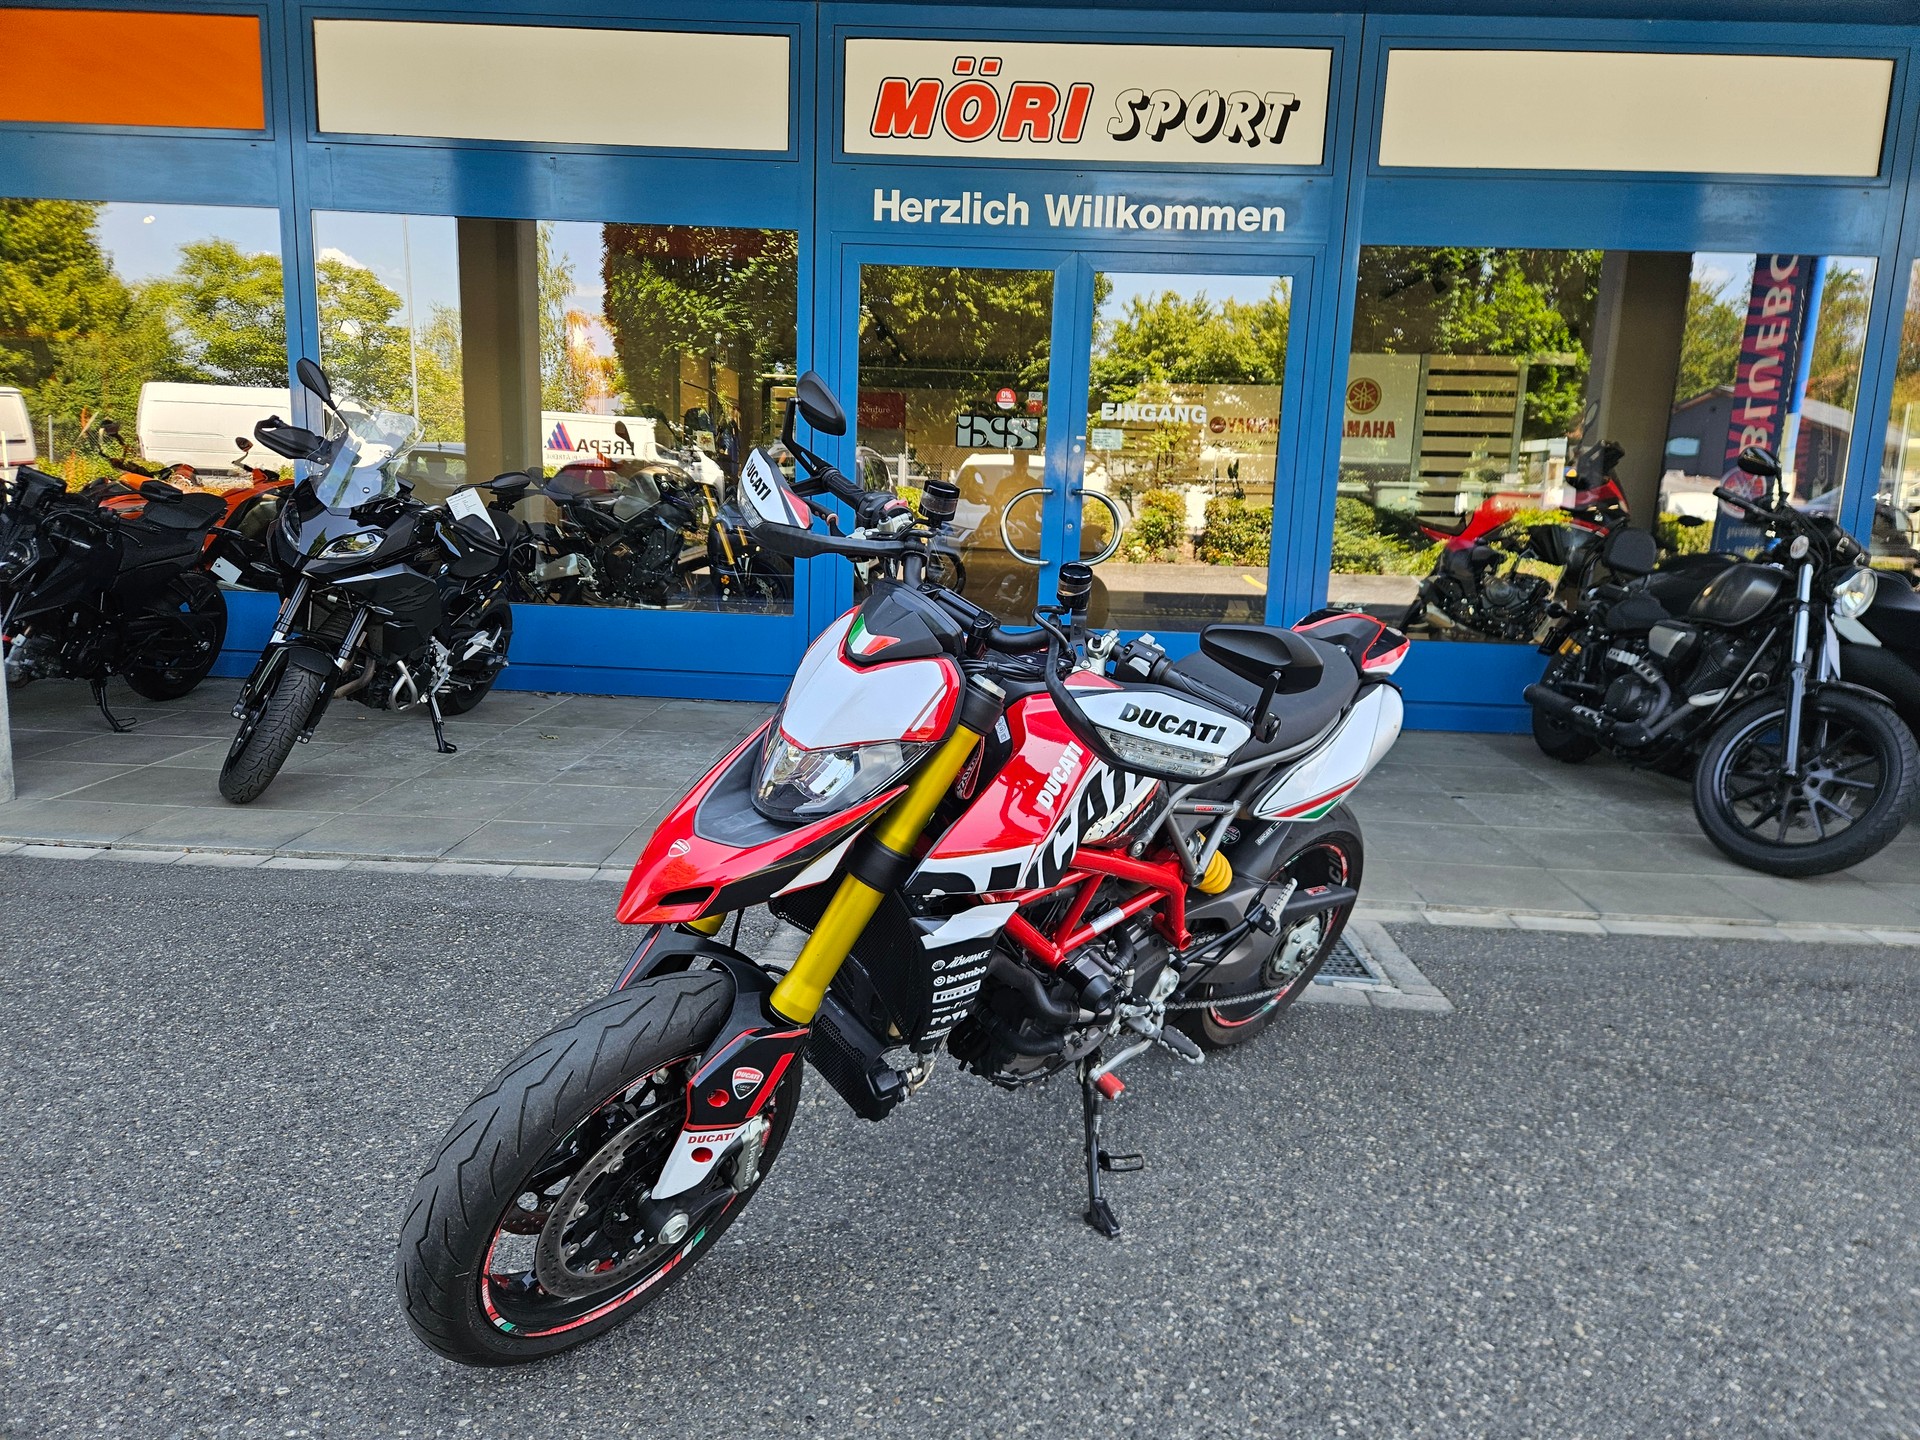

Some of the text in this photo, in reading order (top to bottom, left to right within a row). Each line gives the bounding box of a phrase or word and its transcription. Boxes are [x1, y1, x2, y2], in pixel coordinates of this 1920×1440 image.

[870, 56, 1300, 147] MÖRI SPORT
[873, 188, 1286, 232] Herzlich Willkommen
[1101, 402, 1207, 423] EINGANG
[747, 458, 772, 501] DUCATI
[1118, 702, 1227, 745] DUCATI
[1035, 740, 1084, 811] DUCATI
[946, 966, 987, 984] brembo
[736, 1070, 761, 1080] DUCATI
[688, 1132, 735, 1144] DUCATI
